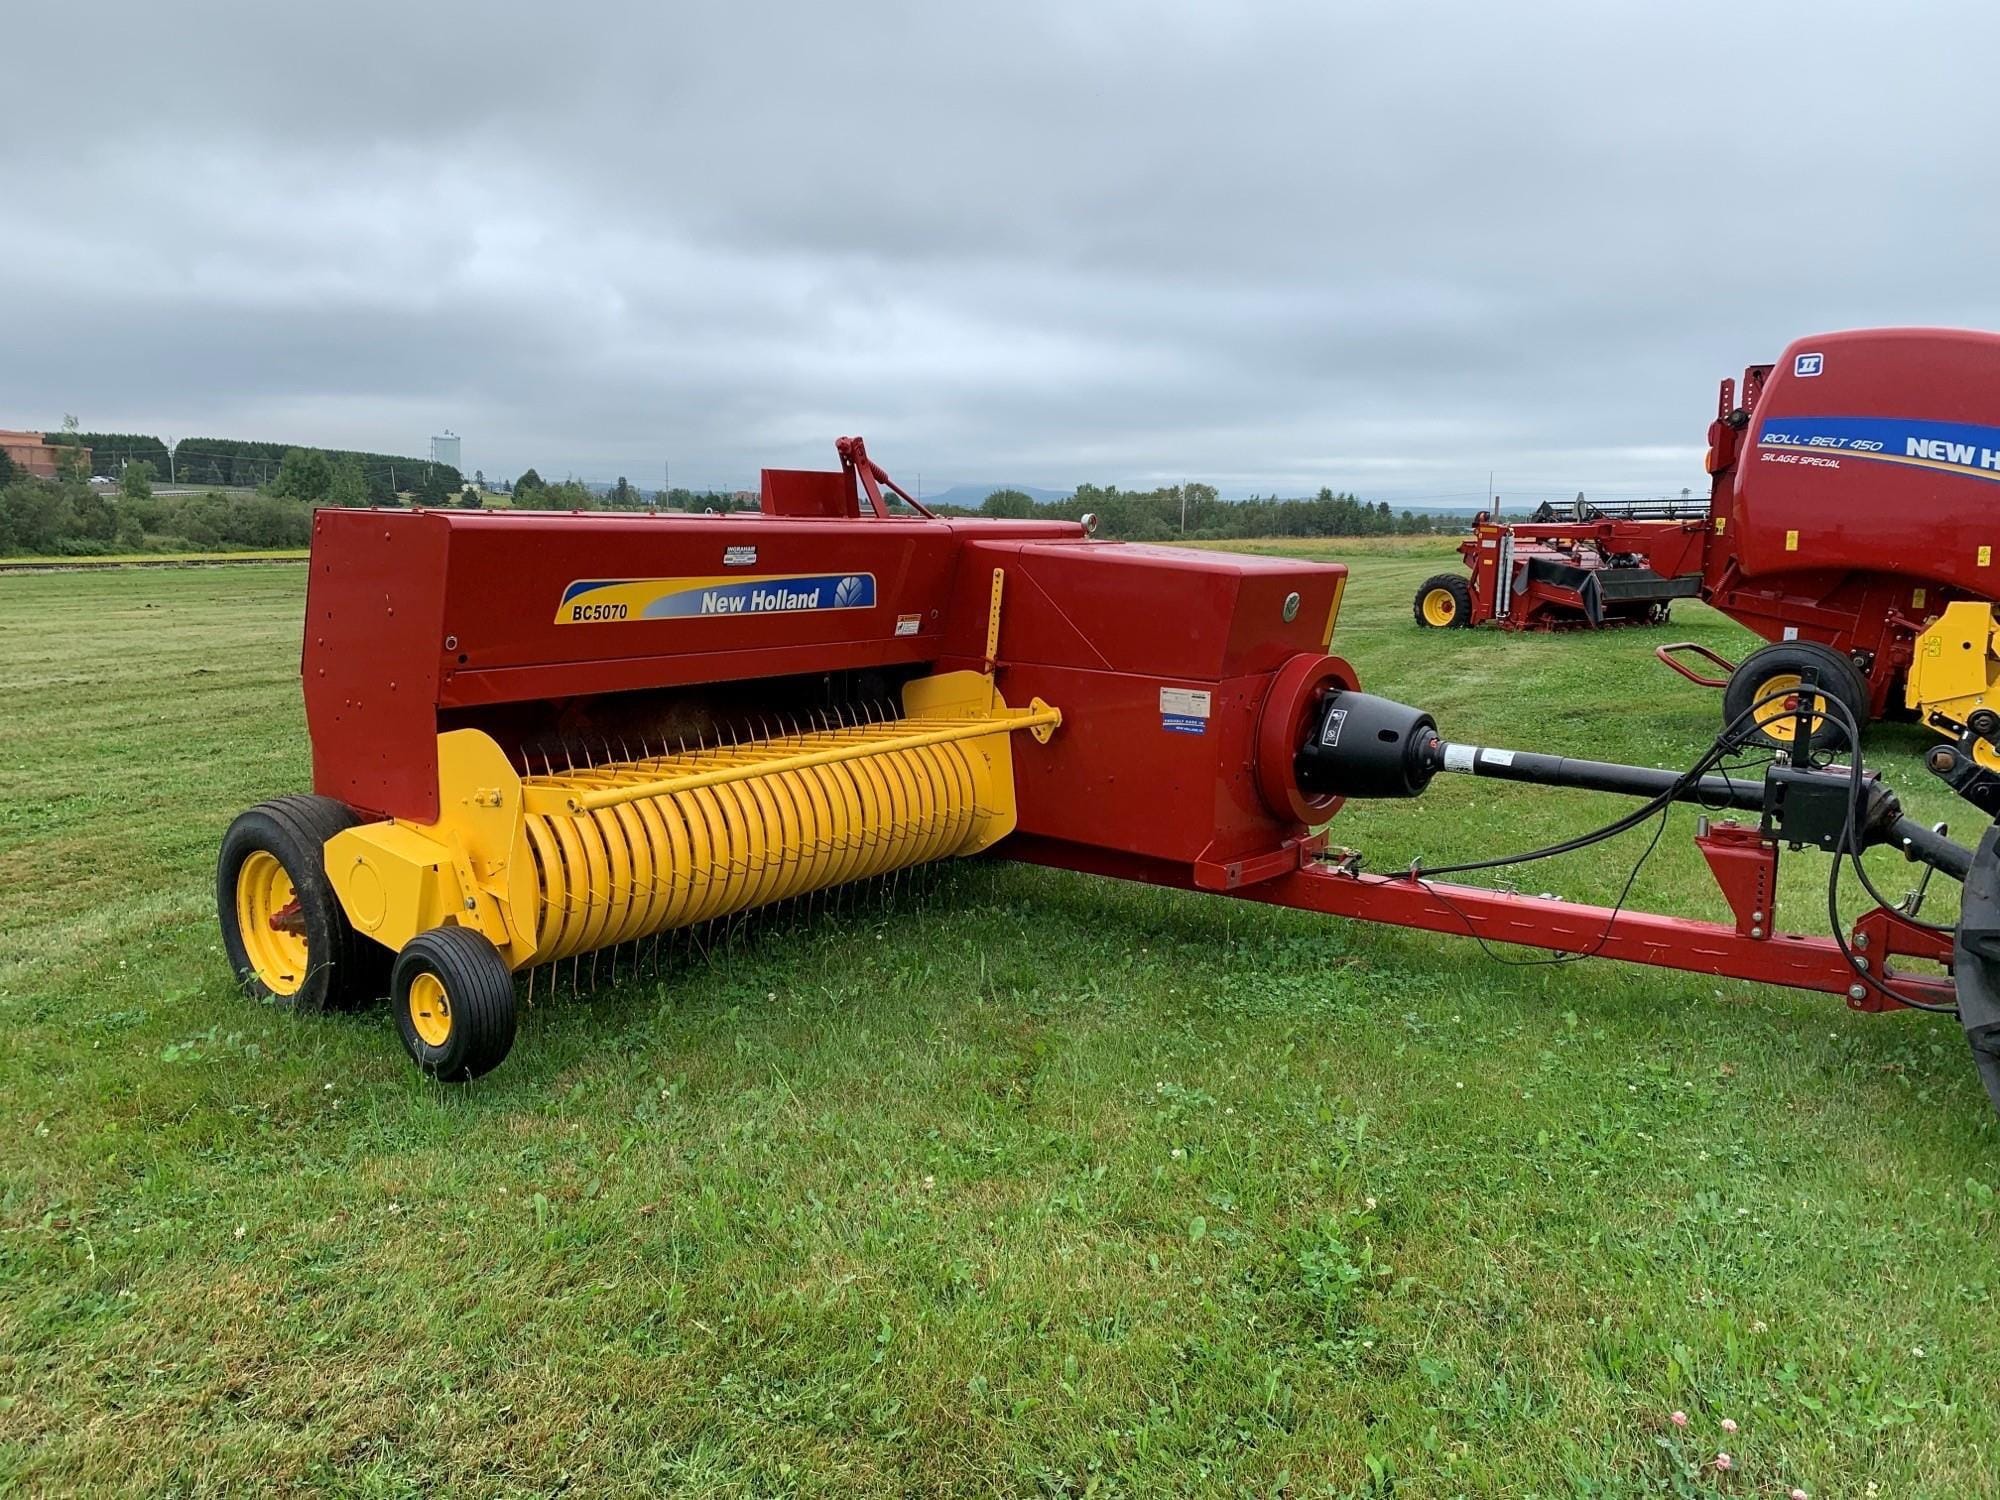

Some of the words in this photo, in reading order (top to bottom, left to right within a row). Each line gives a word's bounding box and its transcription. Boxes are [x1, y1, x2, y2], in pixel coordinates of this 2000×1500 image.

[1762, 433, 1849, 449] ROLL-BELT
[1849, 439, 1884, 451] 450
[1906, 437, 1976, 465] NEW
[1760, 453, 1800, 464] SILAGE
[1799, 456, 1841, 469] SPECIAL
[701, 591, 747, 614] New
[750, 587, 820, 611] Holland
[572, 604, 628, 621] BC5070
